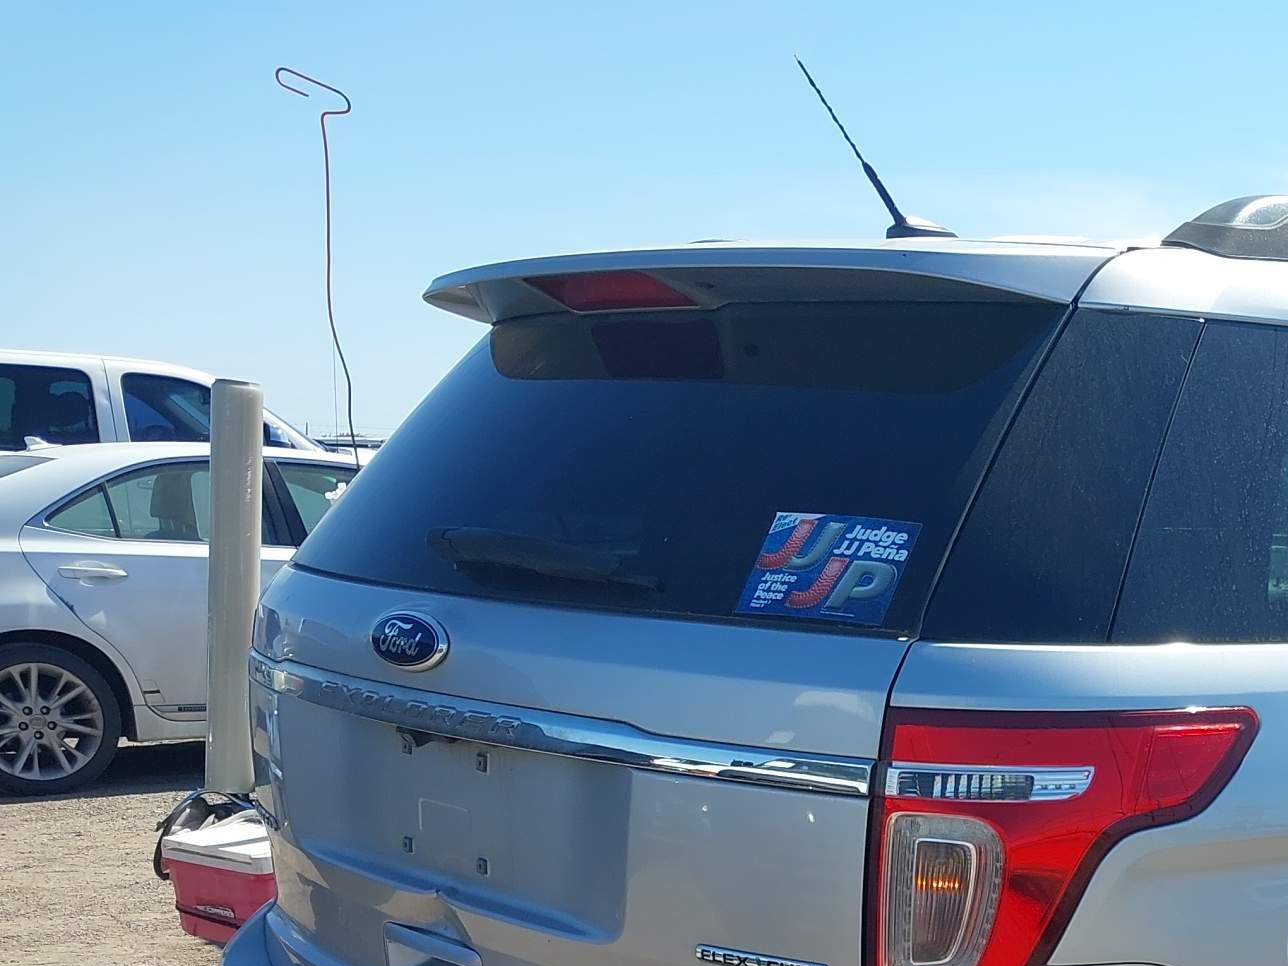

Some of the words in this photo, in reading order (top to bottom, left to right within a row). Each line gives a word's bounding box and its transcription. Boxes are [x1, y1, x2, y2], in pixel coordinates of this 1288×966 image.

[845, 524, 909, 546] Judge
[833, 540, 860, 556] JJ
[857, 541, 909, 562] Peña
[761, 572, 798, 583] Justice
[754, 590, 784, 600] Peace
[758, 582, 772, 590] of
[770, 582, 788, 592] the
[380, 619, 422, 656] Ford
